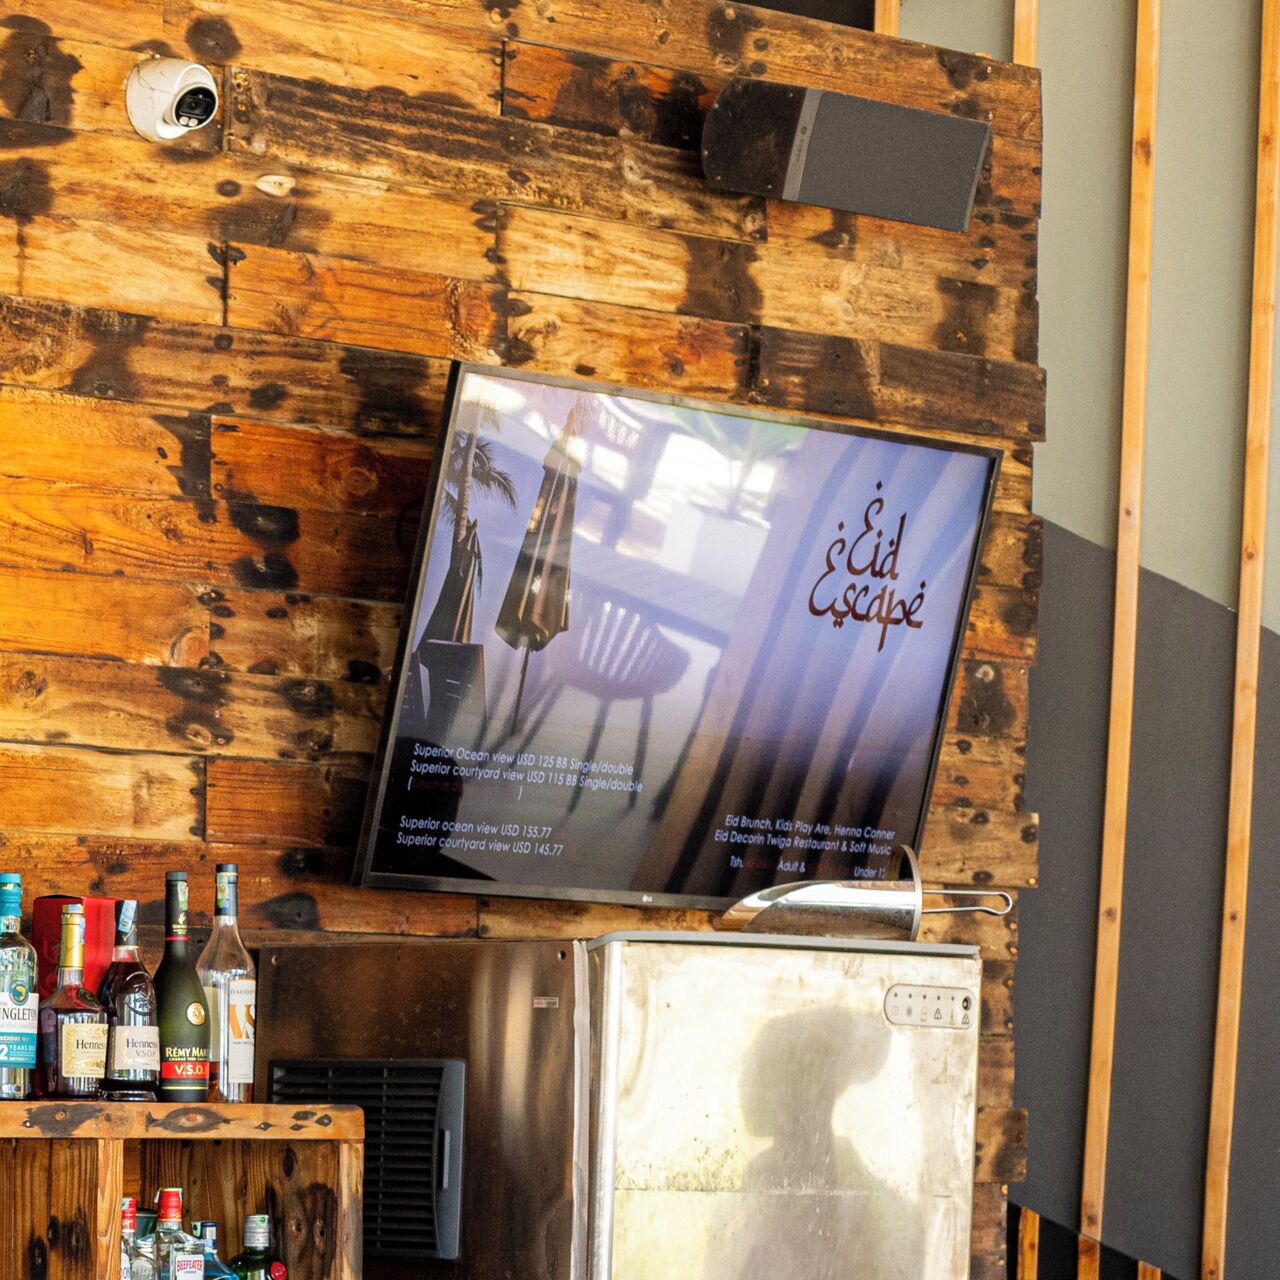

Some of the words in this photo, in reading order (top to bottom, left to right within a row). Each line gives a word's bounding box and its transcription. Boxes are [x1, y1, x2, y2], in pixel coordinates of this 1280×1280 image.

[847, 480, 907, 581] Eid
[808, 521, 926, 653] Escape
[413, 743, 453, 758] Superior
[458, 747, 489, 761] Ocean
[492, 751, 515, 763] view
[517, 753, 535, 766] USD
[539, 755, 554, 767] 125
[556, 756, 568, 768] BB
[570, 758, 634, 776] Single/double
[410, 760, 451, 776] Superior
[453, 765, 500, 781] courtyard
[503, 768, 524, 781] view
[527, 770, 545, 784] USD
[548, 772, 564, 785] 115
[565, 773, 578, 786] BB
[579, 776, 643, 793] Single/double
[400, 815, 440, 831] Superior
[442, 821, 473, 834] ocean
[476, 823, 499, 835] view
[501, 824, 520, 837] USD
[522, 825, 552, 840] 155.77
[725, 814, 739, 827] Eid
[740, 816, 773, 831] Brunch,
[775, 819, 793, 831] Kids
[795, 821, 814, 835] Play
[864, 827, 896, 841] Conner
[397, 831, 437, 847] Superior
[439, 836, 486, 851] courtyard
[488, 839, 510, 852] view
[513, 841, 531, 854] USD
[534, 842, 564, 857] 145.77
[715, 829, 728, 842] Eid
[730, 831, 764, 846] Decorin
[766, 835, 791, 849] Twiga
[793, 837, 840, 851] Restaurant
[841, 841, 847, 851] &
[849, 841, 866, 853] Soft
[868, 843, 892, 855] Music
[777, 861, 800, 872] Adult
[799, 862, 806, 873] &
[854, 866, 877, 878] Under
[166, 1046, 191, 1058] RÉMY
[177, 1260, 204, 1272] BEEFEATER
